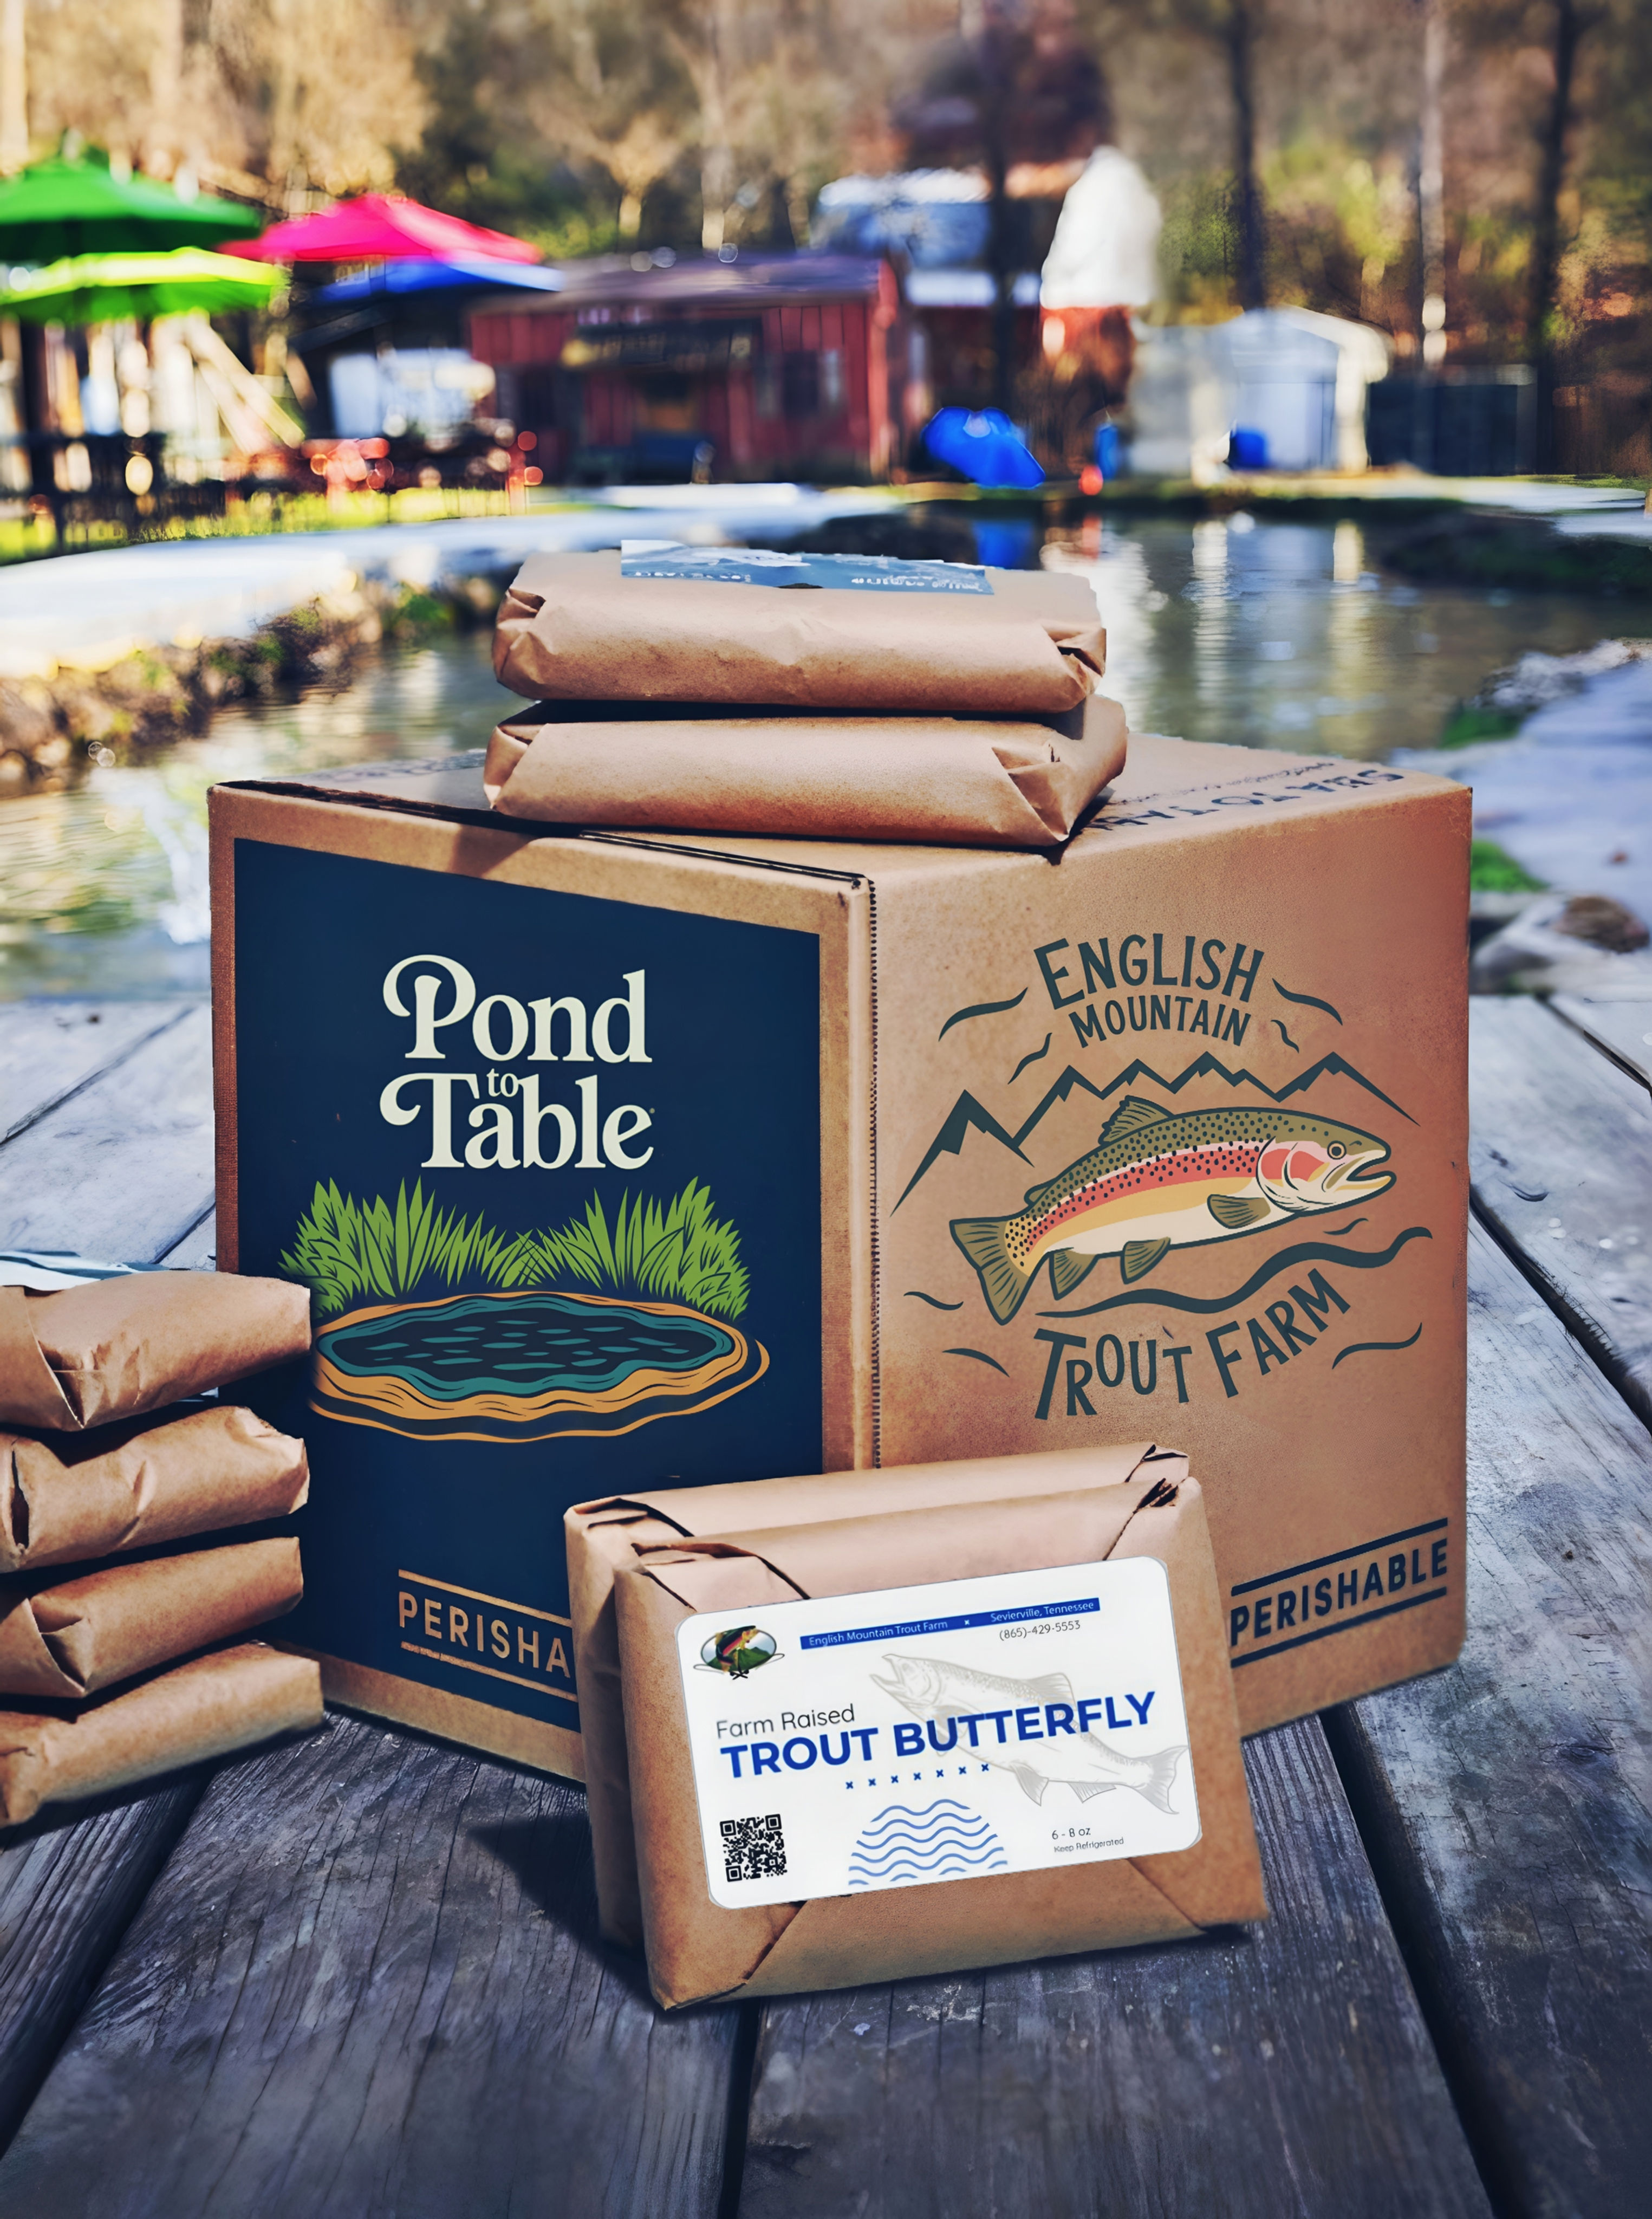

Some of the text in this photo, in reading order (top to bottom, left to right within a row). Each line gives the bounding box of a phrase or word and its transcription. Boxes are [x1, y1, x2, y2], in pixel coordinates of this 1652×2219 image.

[1033, 933, 1265, 1009] ENGLISH
[383, 954, 652, 1063] Pond
[1069, 995, 1251, 1048] MOUNTAIN
[487, 1068, 519, 1097] to
[380, 1073, 654, 1170] Table
[1033, 1268, 1351, 1420] TROUT FARM
[1043, 1601, 1094, 1615] Tennessee
[1231, 1538, 1447, 1647] PERISHABLE
[809, 1620, 948, 1647] English Mountain Trout Farm
[999, 1620, 1081, 1641] (865)-429-5553
[717, 1703, 855, 1739] Farm Raised
[720, 1691, 1155, 1778] TROUT BUTTERFLY
[1052, 1829, 1059, 1840] 6
[1069, 1827, 1076, 1838] 8
[1078, 1827, 1091, 1837] oz
[1054, 1837, 1124, 1853] Keep Refrigerated
